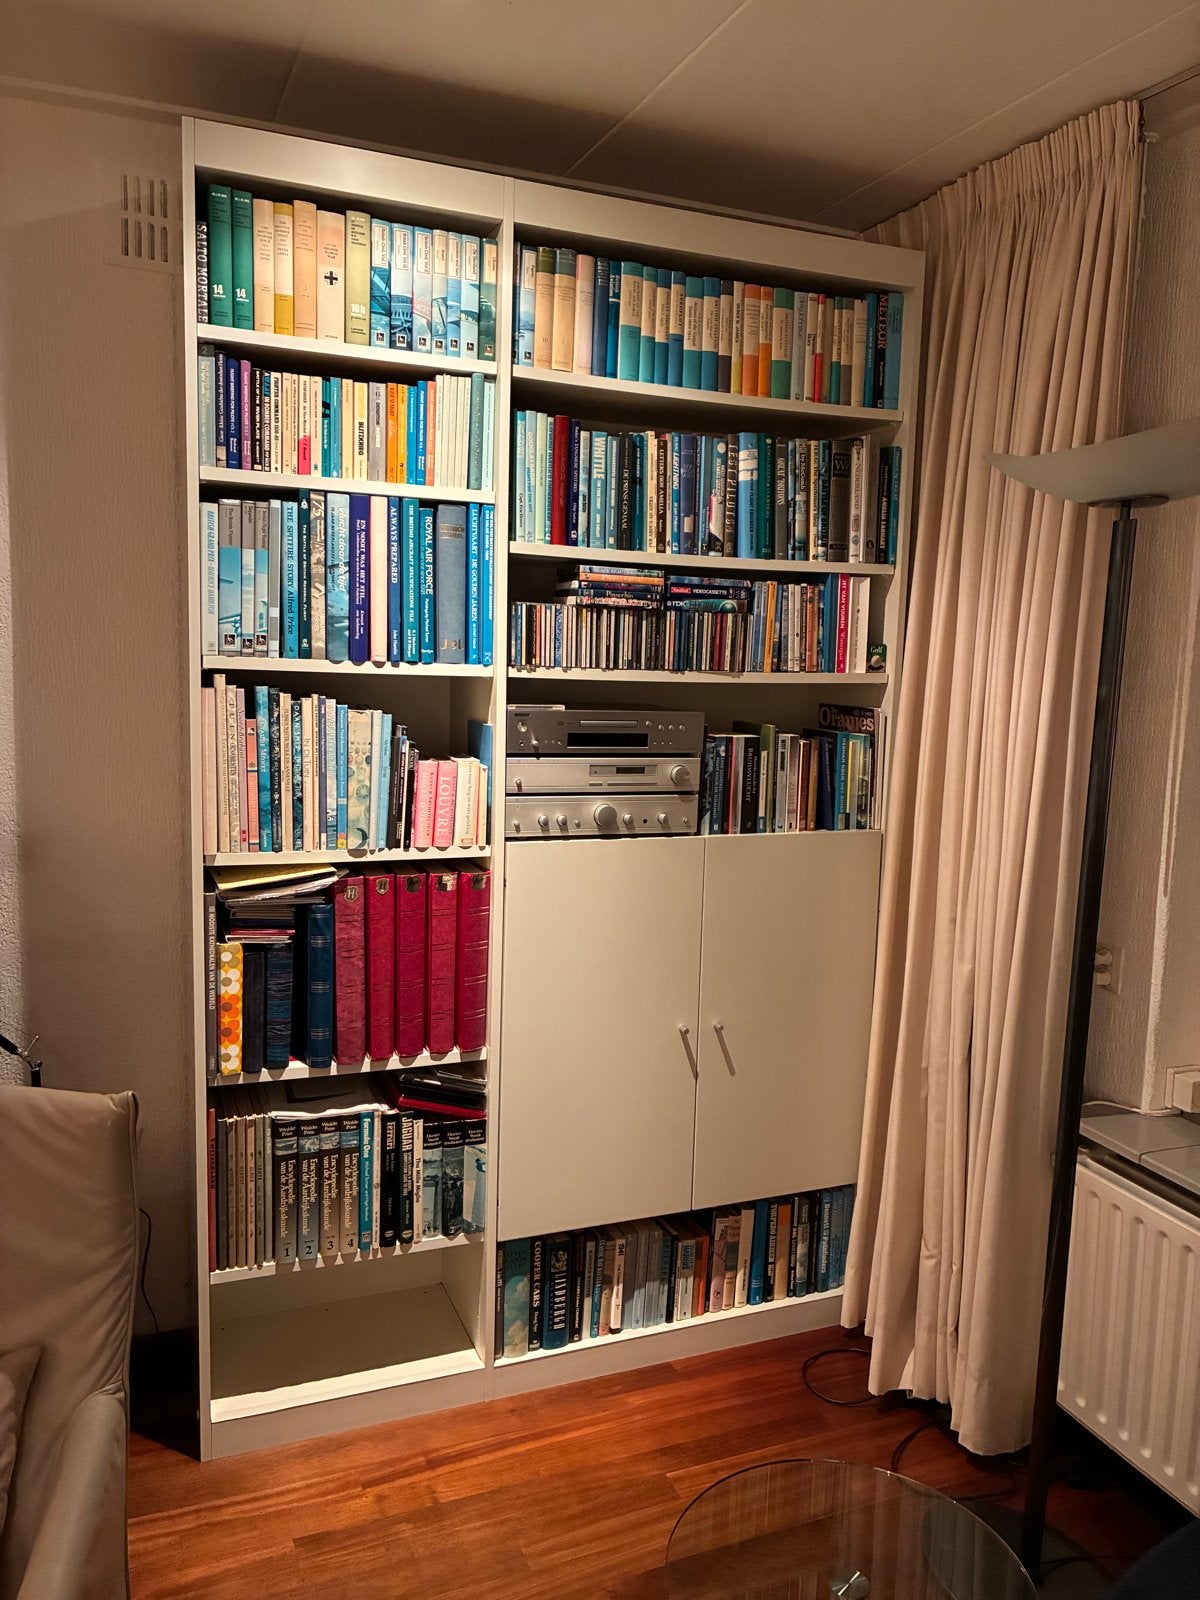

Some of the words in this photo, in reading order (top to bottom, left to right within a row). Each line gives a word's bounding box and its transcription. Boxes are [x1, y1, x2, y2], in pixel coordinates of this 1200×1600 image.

[197, 224, 207, 264] SALTO
[197, 267, 209, 323] MORTALE
[212, 284, 224, 295] 14
[235, 288, 246, 298] 14
[877, 294, 888, 349] METEOR
[593, 437, 606, 479] WHITTLE
[777, 457, 785, 477] GREAT
[854, 462, 862, 510] NEDERLAND
[207, 510, 215, 531] BRITISH
[286, 506, 294, 523] THE
[312, 499, 324, 517] 75
[338, 507, 346, 536] vlucht
[360, 520, 366, 530] EN
[390, 506, 398, 541] ALWAYS
[207, 531, 215, 549] GRAND
[879, 521, 887, 549] EARHART
[207, 550, 215, 562] PRIX
[338, 537, 346, 562] door
[287, 563, 295, 588] STORY
[471, 558, 478, 569] DE
[338, 575, 346, 591] tijd
[425, 565, 433, 595] FORCE
[287, 590, 295, 614] Alfred
[287, 616, 295, 635] Price
[745, 748, 754, 802] BRUIDSVLUCHT
[437, 776, 451, 836] LOUVRE
[401, 1117, 412, 1151] JAGUAR
[281, 1175, 287, 1184] de
[287, 1160, 295, 1204] Encyclopedie
[302, 1174, 309, 1182] de
[309, 1158, 317, 1203] Encyclopedie
[324, 1170, 330, 1178] de
[330, 1154, 338, 1199] Encyclopedie
[280, 1185, 288, 1238] Aardrijkskunde
[302, 1182, 310, 1235] Aardrijkskunde
[323, 1179, 331, 1231] Aardrijkskunde
[823, 1204, 831, 1229] Bennett
[770, 1204, 778, 1234] TORPEDO
[284, 1248, 291, 1258] 1
[305, 1245, 312, 1255] 2
[326, 1241, 334, 1251] 3
[348, 1239, 354, 1247] 4
[617, 1243, 625, 1256] 1941
[821, 1236, 829, 1273] Pathfinders
[534, 1241, 542, 1281] COOPER
[532, 1282, 541, 1307] CARS
[553, 1274, 567, 1330] LINDBERGH
